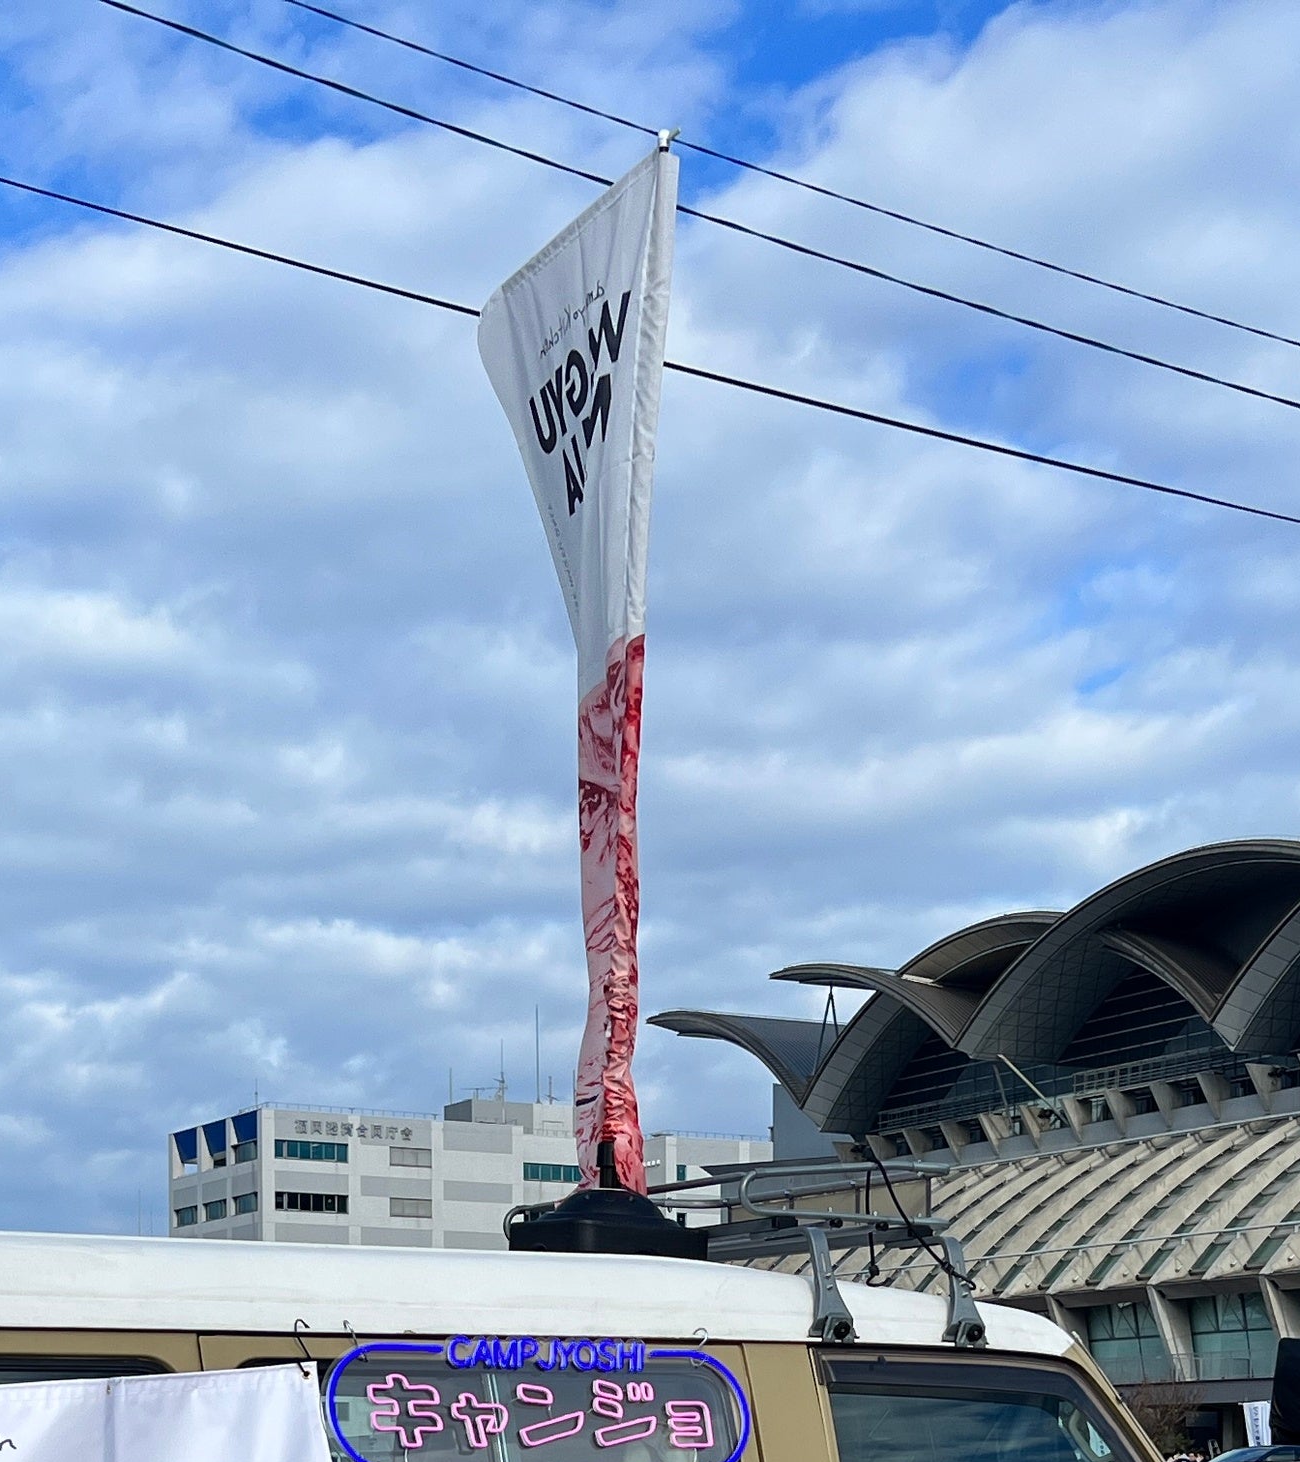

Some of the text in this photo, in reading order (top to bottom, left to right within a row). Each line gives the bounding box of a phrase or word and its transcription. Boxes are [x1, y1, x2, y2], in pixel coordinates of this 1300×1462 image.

[447, 1336, 645, 1372] CAMP JYOSHI
[367, 1373, 714, 1449] キャンジョ
